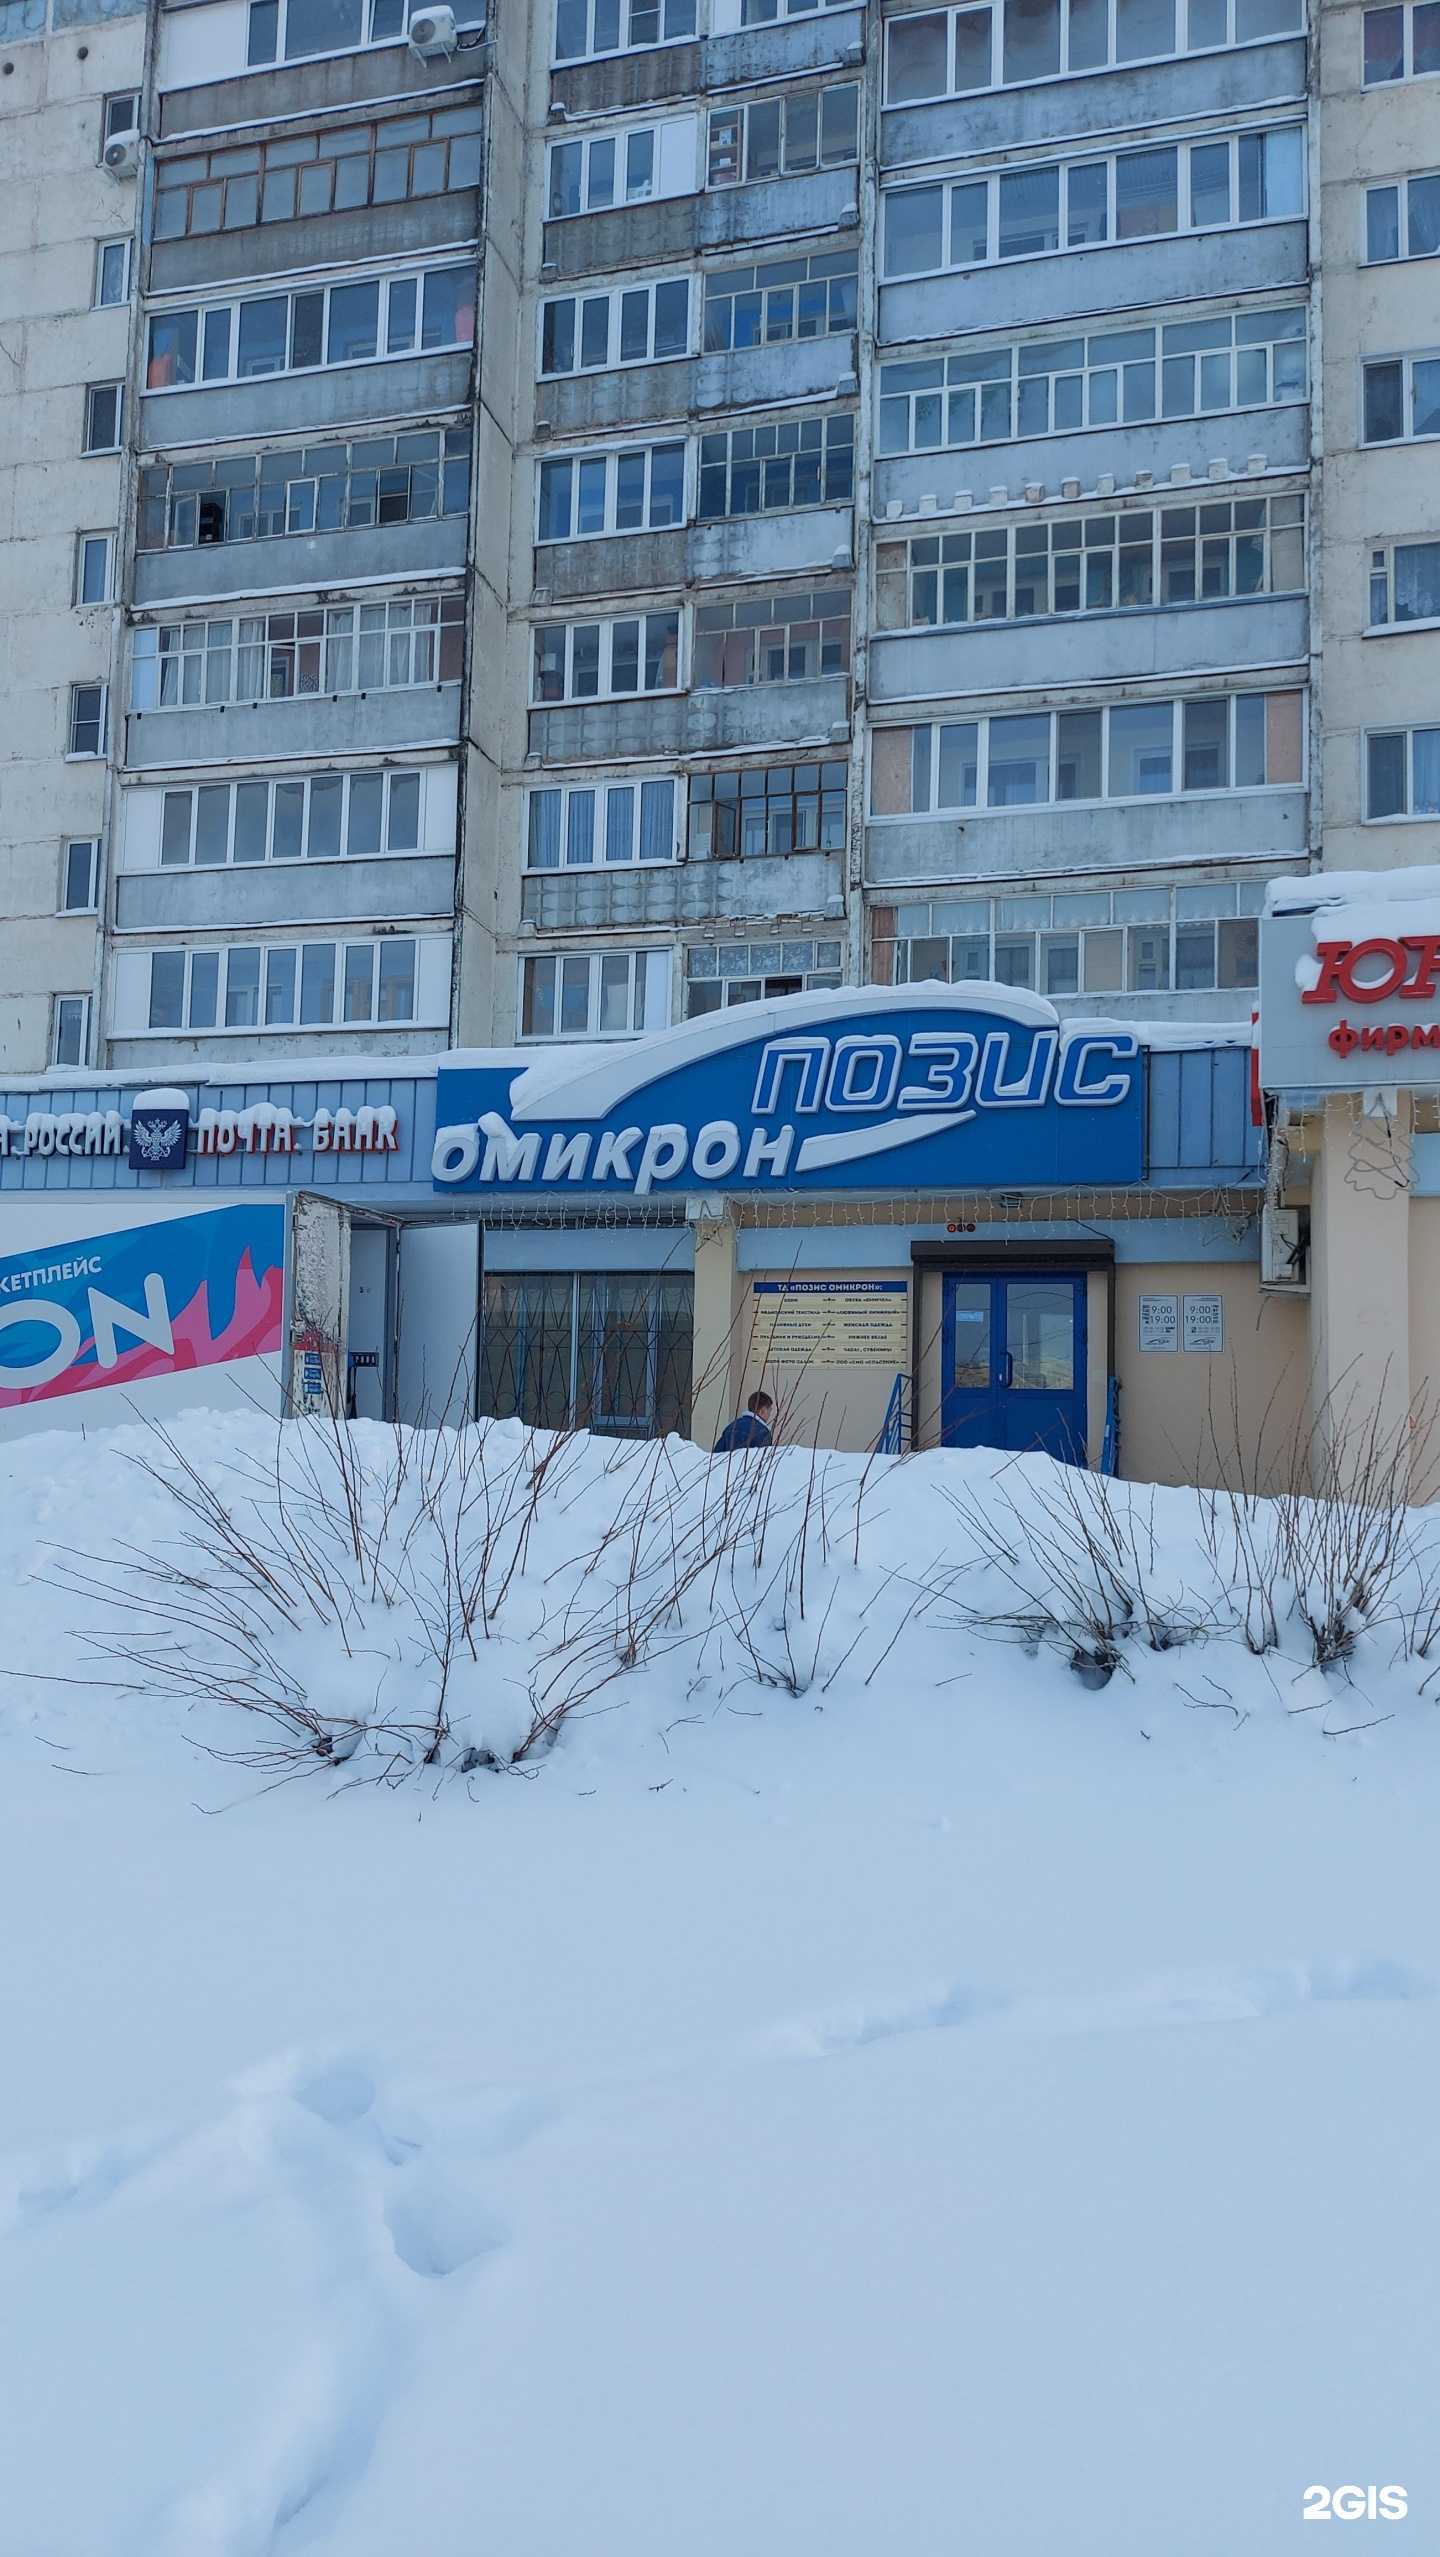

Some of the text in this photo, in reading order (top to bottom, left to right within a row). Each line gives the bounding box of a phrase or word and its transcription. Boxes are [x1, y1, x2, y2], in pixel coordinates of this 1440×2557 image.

[751, 1031, 1138, 1114] ПОЗИС
[198, 1101, 398, 1155] ПОЧТА БАНК
[1151, 1305, 1172, 1314] 9:00
[1190, 1305, 1211, 1314] 9:00
[1150, 1315, 1176, 1324] 19:00
[1185, 1315, 1212, 1324] 19:00
